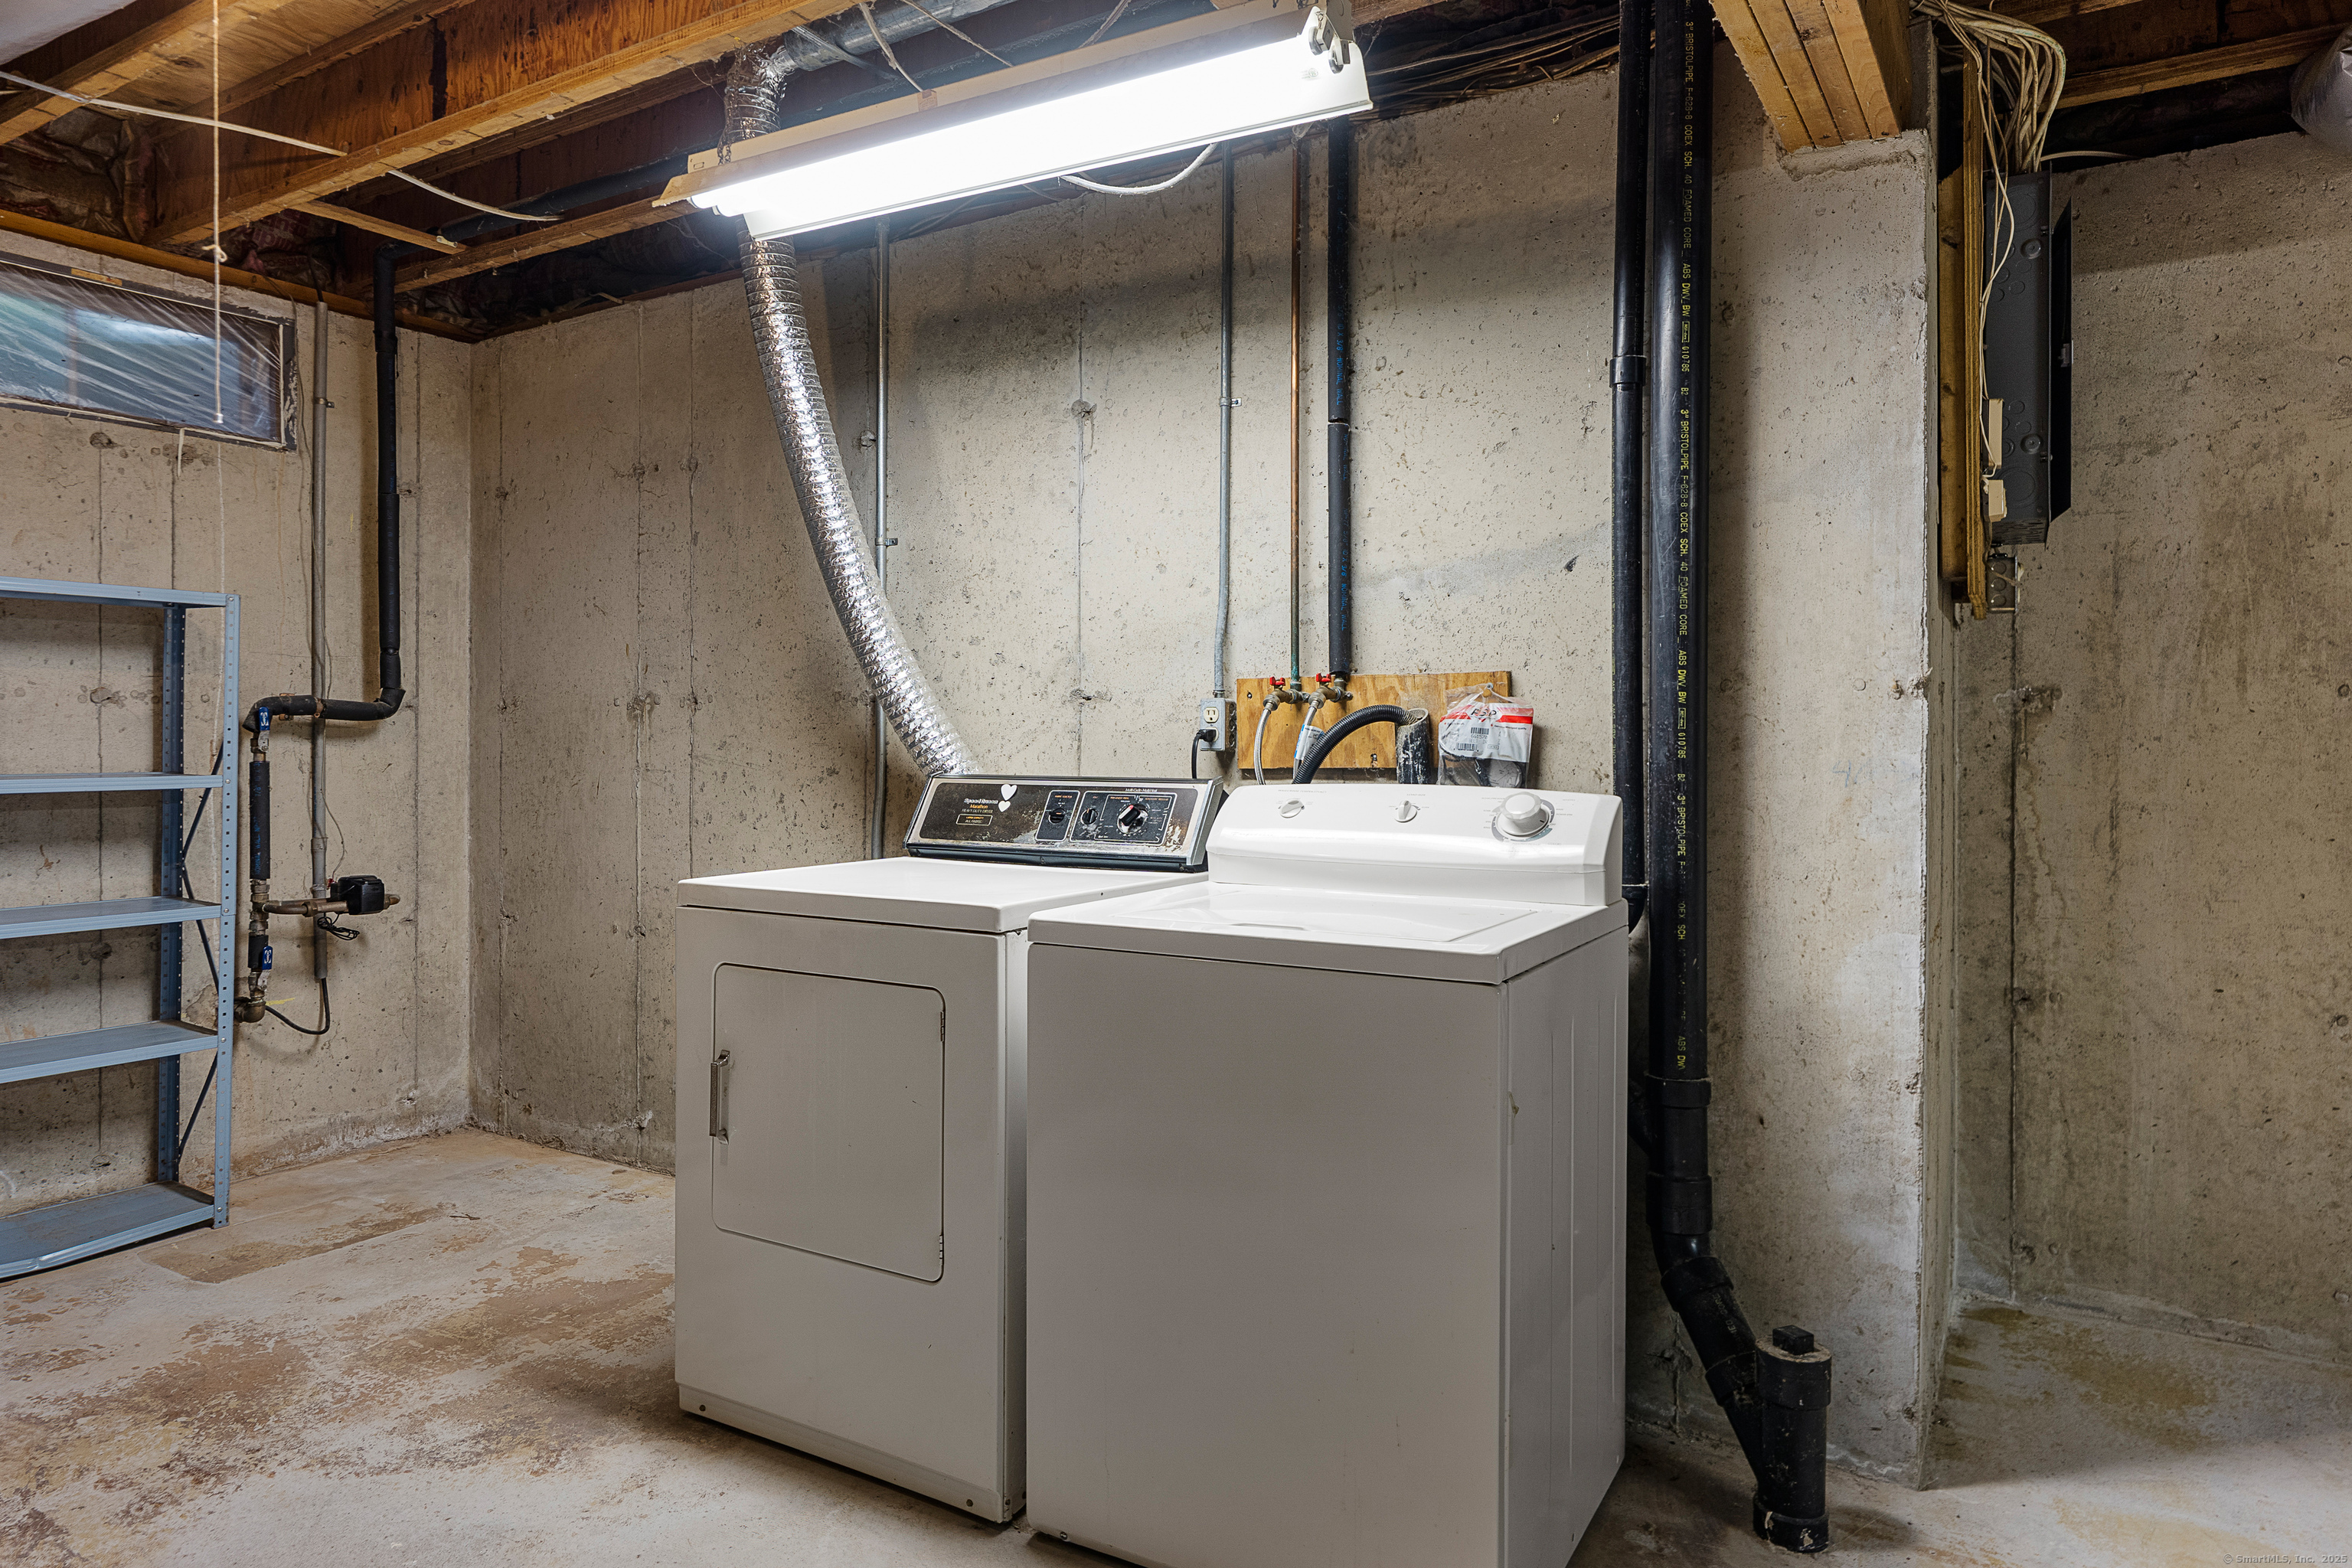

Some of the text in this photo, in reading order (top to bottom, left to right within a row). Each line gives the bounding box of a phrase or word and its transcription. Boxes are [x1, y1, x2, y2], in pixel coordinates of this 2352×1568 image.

[1685, 33, 1694, 83] BRISTOLPIPE
[1684, 124, 1693, 146] COEX
[1684, 151, 1693, 169] SCH.
[1684, 174, 1693, 185] 40
[1684, 189, 1693, 222] FOAMED
[1684, 227, 1692, 249] CORE
[1683, 263, 1691, 279] ABS
[1682, 283, 1691, 300] DWV
[1682, 305, 1690, 317] BW
[1681, 387, 1689, 396] B2
[1681, 420, 1689, 470] BRISTOLPIPE
[1681, 475, 1689, 507] F-628-8
[1680, 511, 1688, 534] COEX
[1680, 538, 1688, 557] SCH.
[1681, 561, 1688, 571] 40
[1679, 576, 1688, 609] FOAMED
[1679, 614, 1687, 635] CORE
[1678, 649, 1687, 665] ABS
[1677, 669, 1687, 687] DWV
[1678, 691, 1687, 704] BW
[1677, 773, 1686, 782] B2
[1677, 807, 1686, 856] BRISTOLPIPE
[1677, 901, 1686, 919] OEX
[1677, 1036, 1686, 1051] ABS
